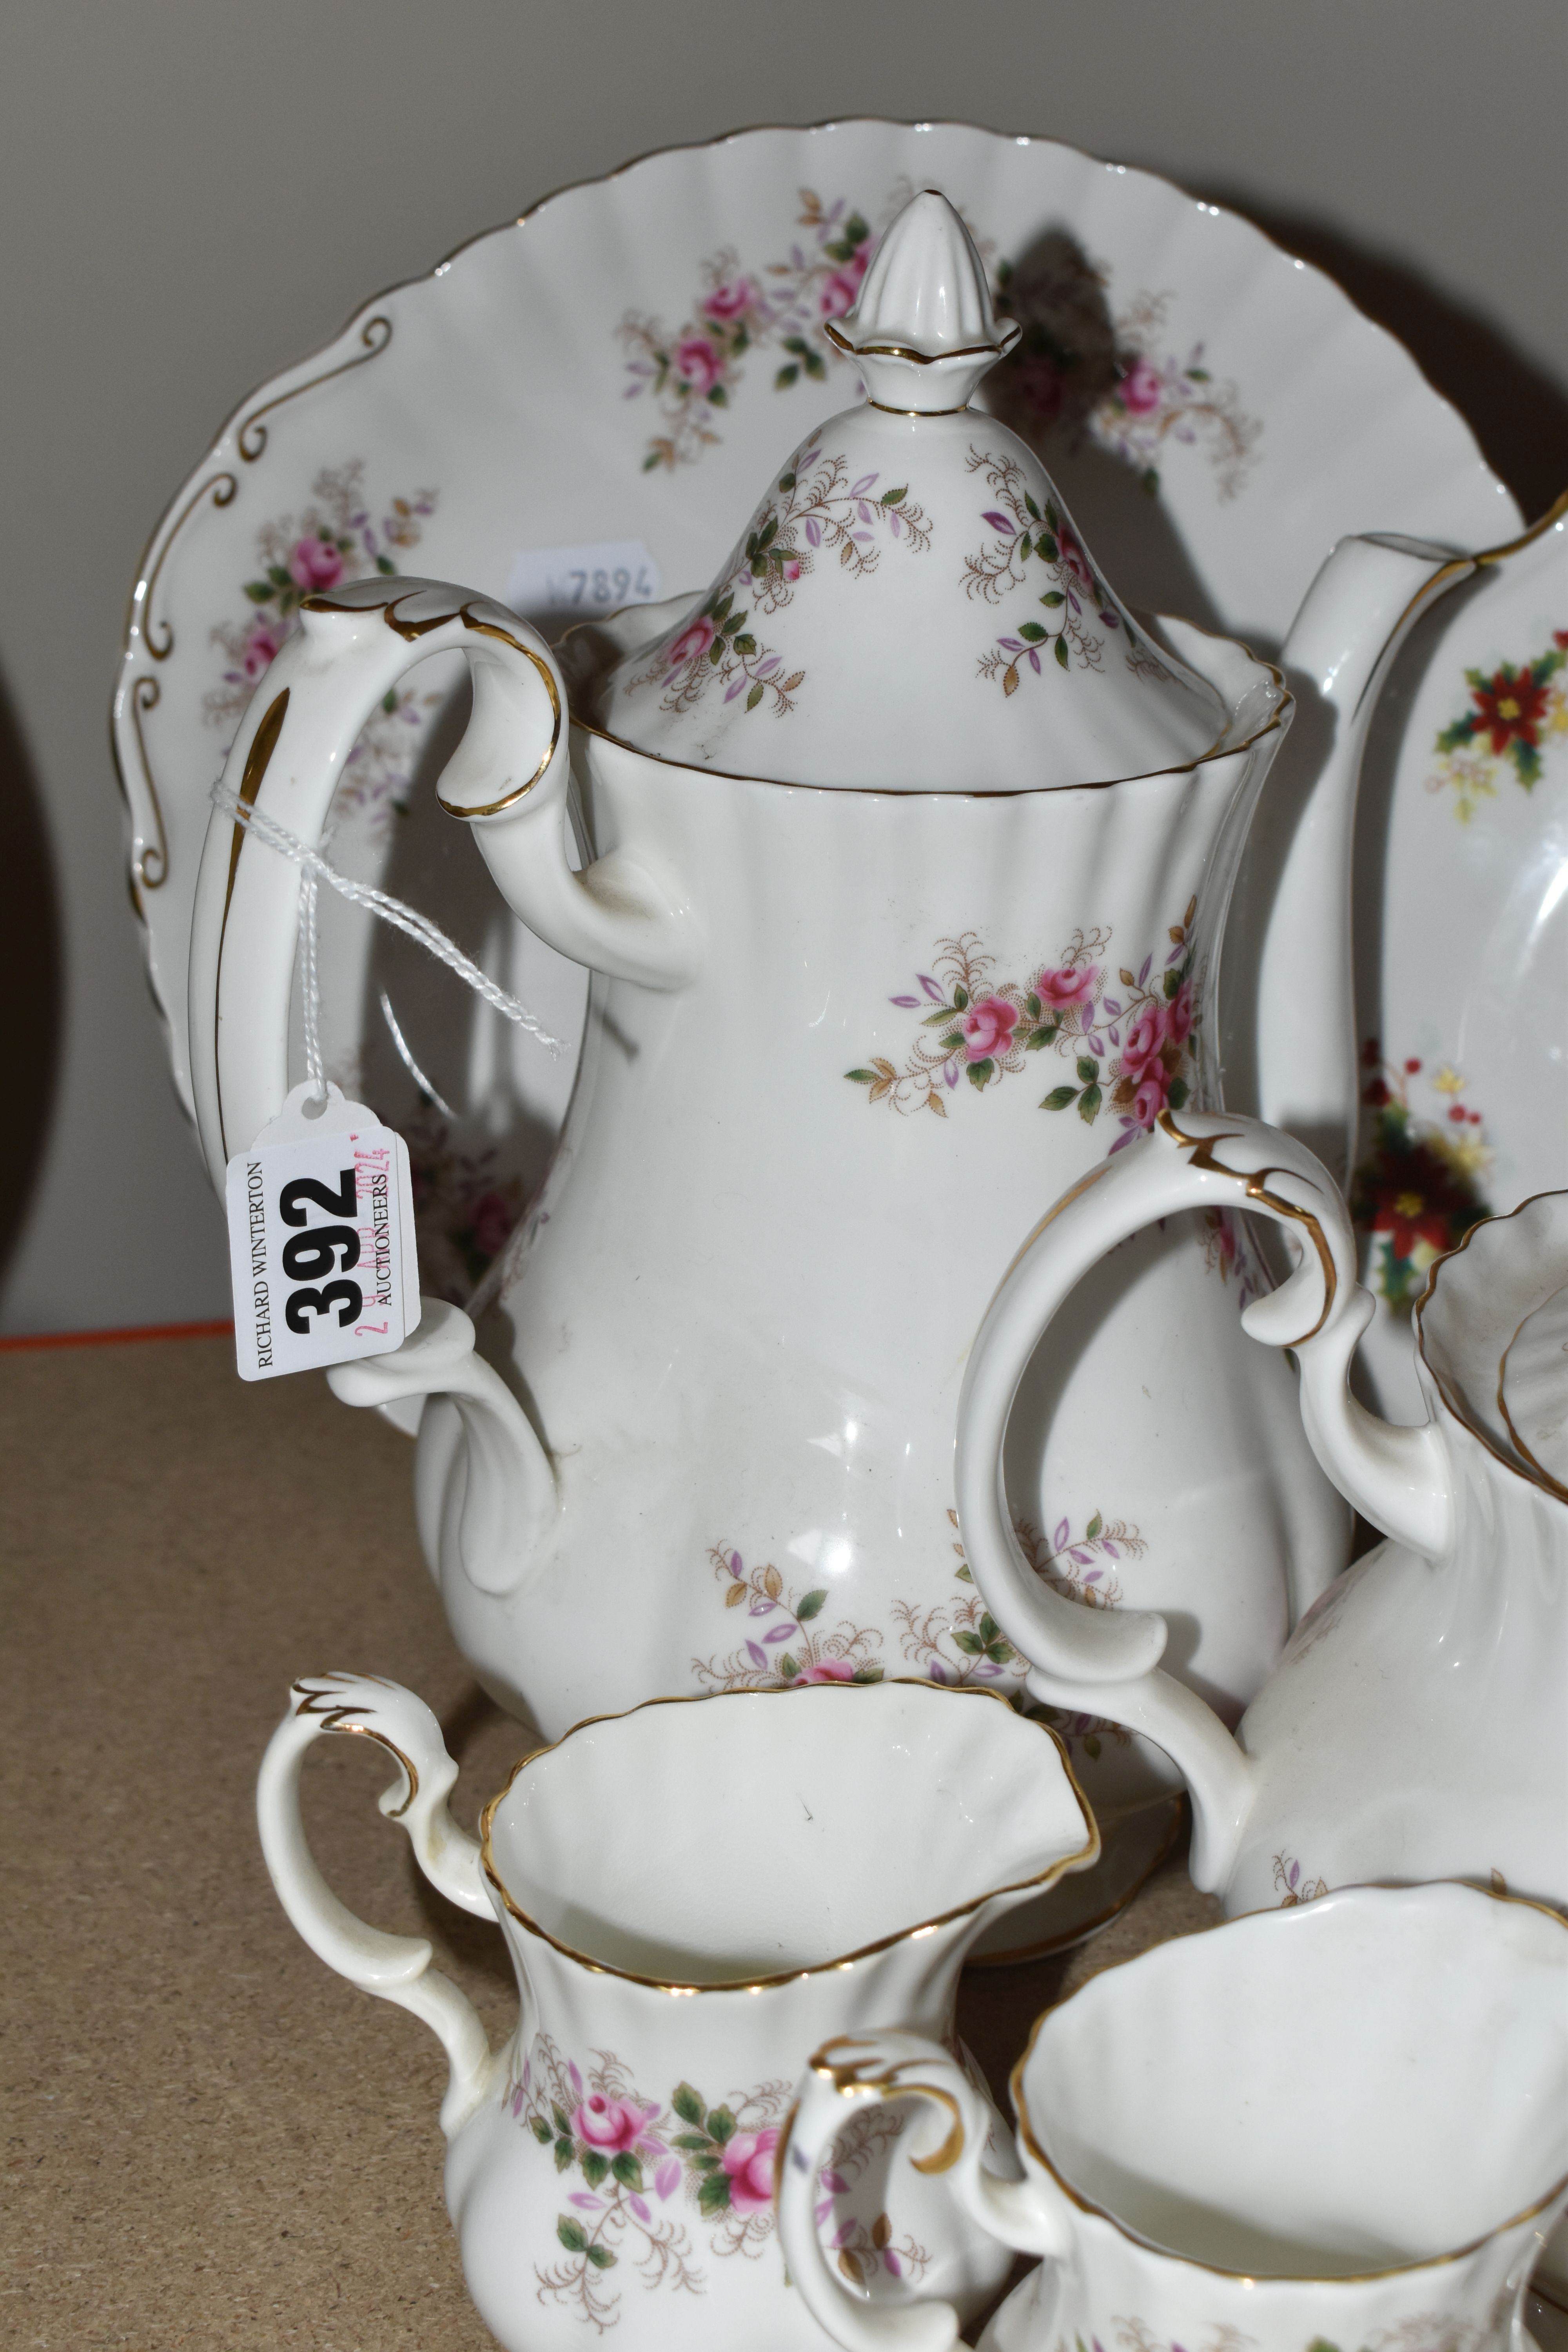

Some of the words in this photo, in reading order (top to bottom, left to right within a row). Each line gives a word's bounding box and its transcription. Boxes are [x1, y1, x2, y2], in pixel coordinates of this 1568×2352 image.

[247, 1161, 267, 1277] WINTERTON
[354, 1148, 390, 1200] 2024
[279, 1168, 363, 1334] 392
[357, 1224, 390, 1269] APR
[372, 1174, 392, 1306] AUCTIONEERS
[254, 1281, 273, 1369] RICHARD
